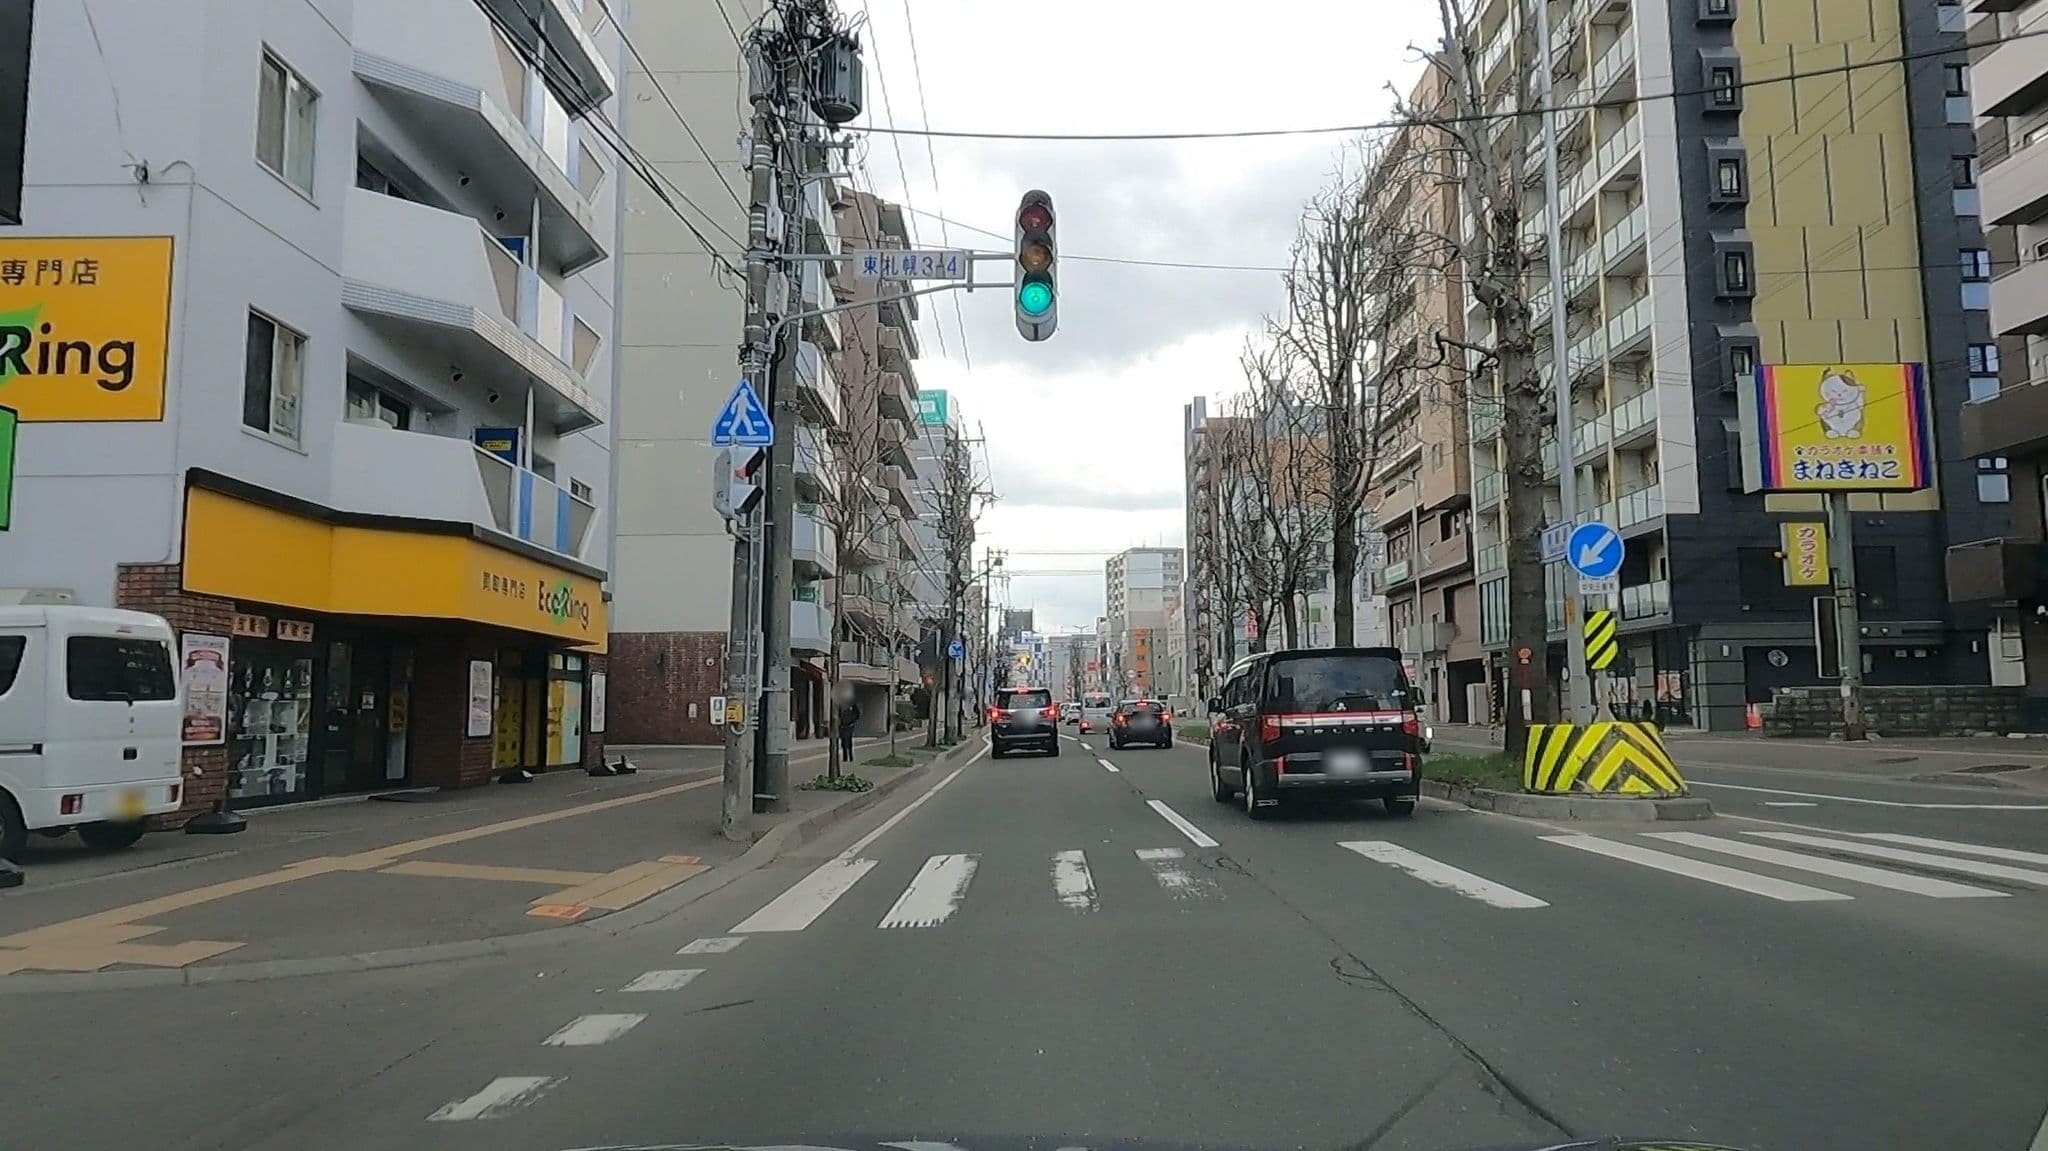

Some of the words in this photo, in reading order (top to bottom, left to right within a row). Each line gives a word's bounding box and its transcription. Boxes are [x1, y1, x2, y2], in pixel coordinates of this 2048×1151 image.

[1, 259, 98, 286] 専門店
[863, 255, 957, 276] 東札幌3-4
[0, 322, 135, 391] Ring
[1794, 459, 1899, 480] まねきねこ
[1799, 527, 1818, 579] カラオケ
